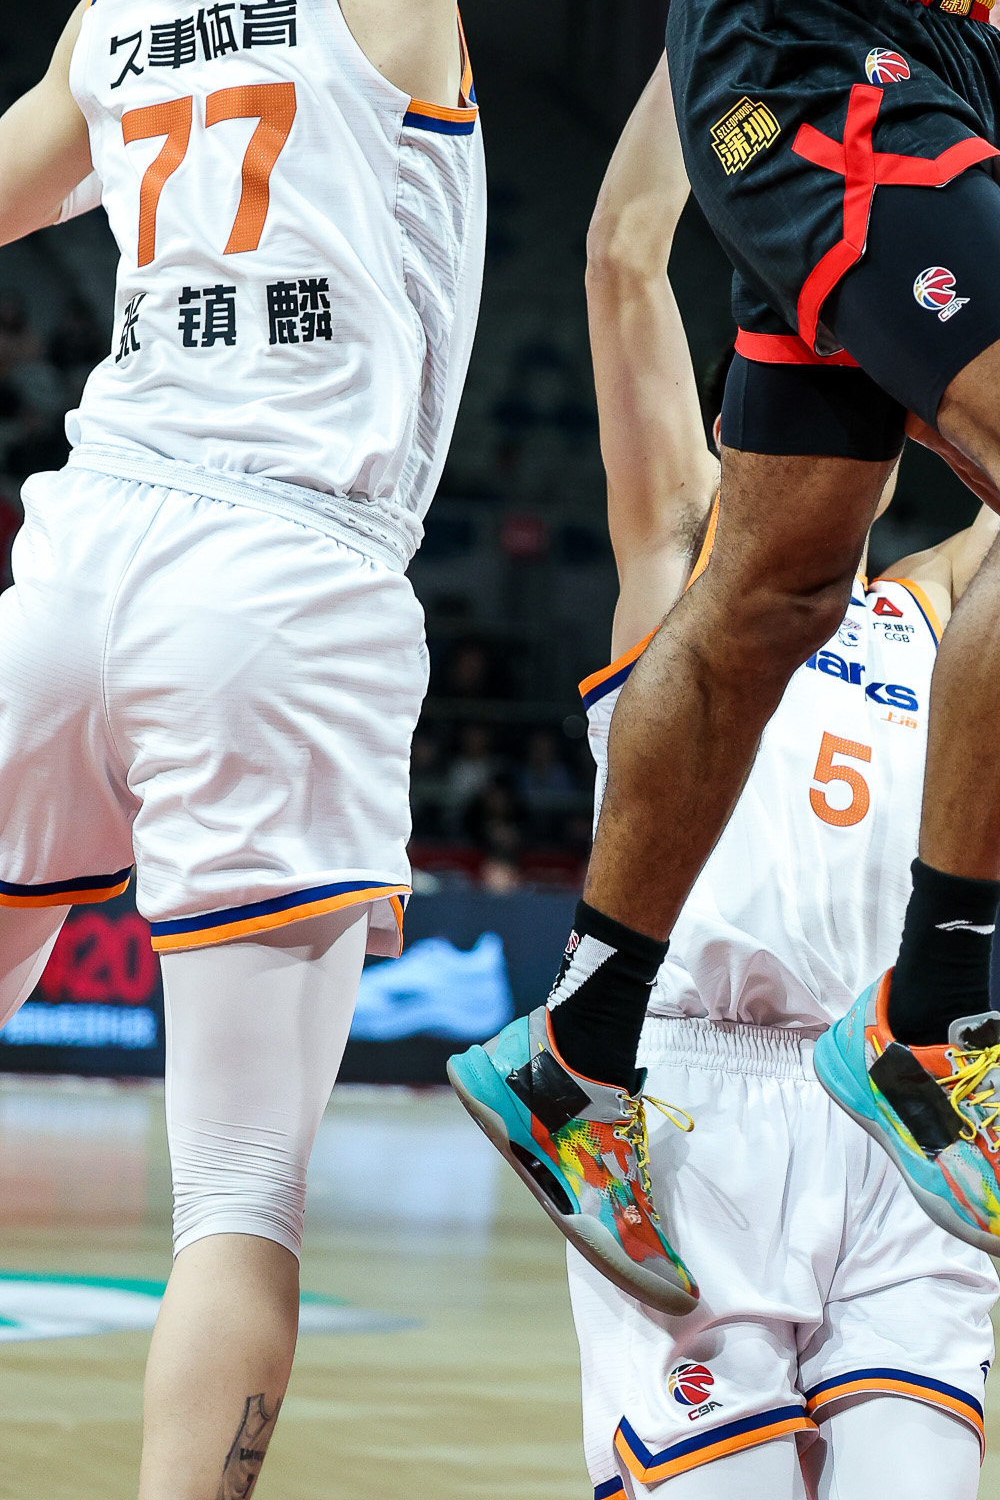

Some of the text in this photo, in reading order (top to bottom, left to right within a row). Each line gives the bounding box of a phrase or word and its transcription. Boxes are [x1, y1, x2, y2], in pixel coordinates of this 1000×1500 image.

[716, 102, 754, 140] SZLEOPARDS
[718, 107, 777, 167] 深圳
[121, 81, 297, 268] 77
[938, 297, 971, 322] CBA
[884, 632, 911, 643] CGB
[805, 649, 919, 712] arks
[808, 730, 873, 828] 5
[686, 1400, 724, 1421] CBA
